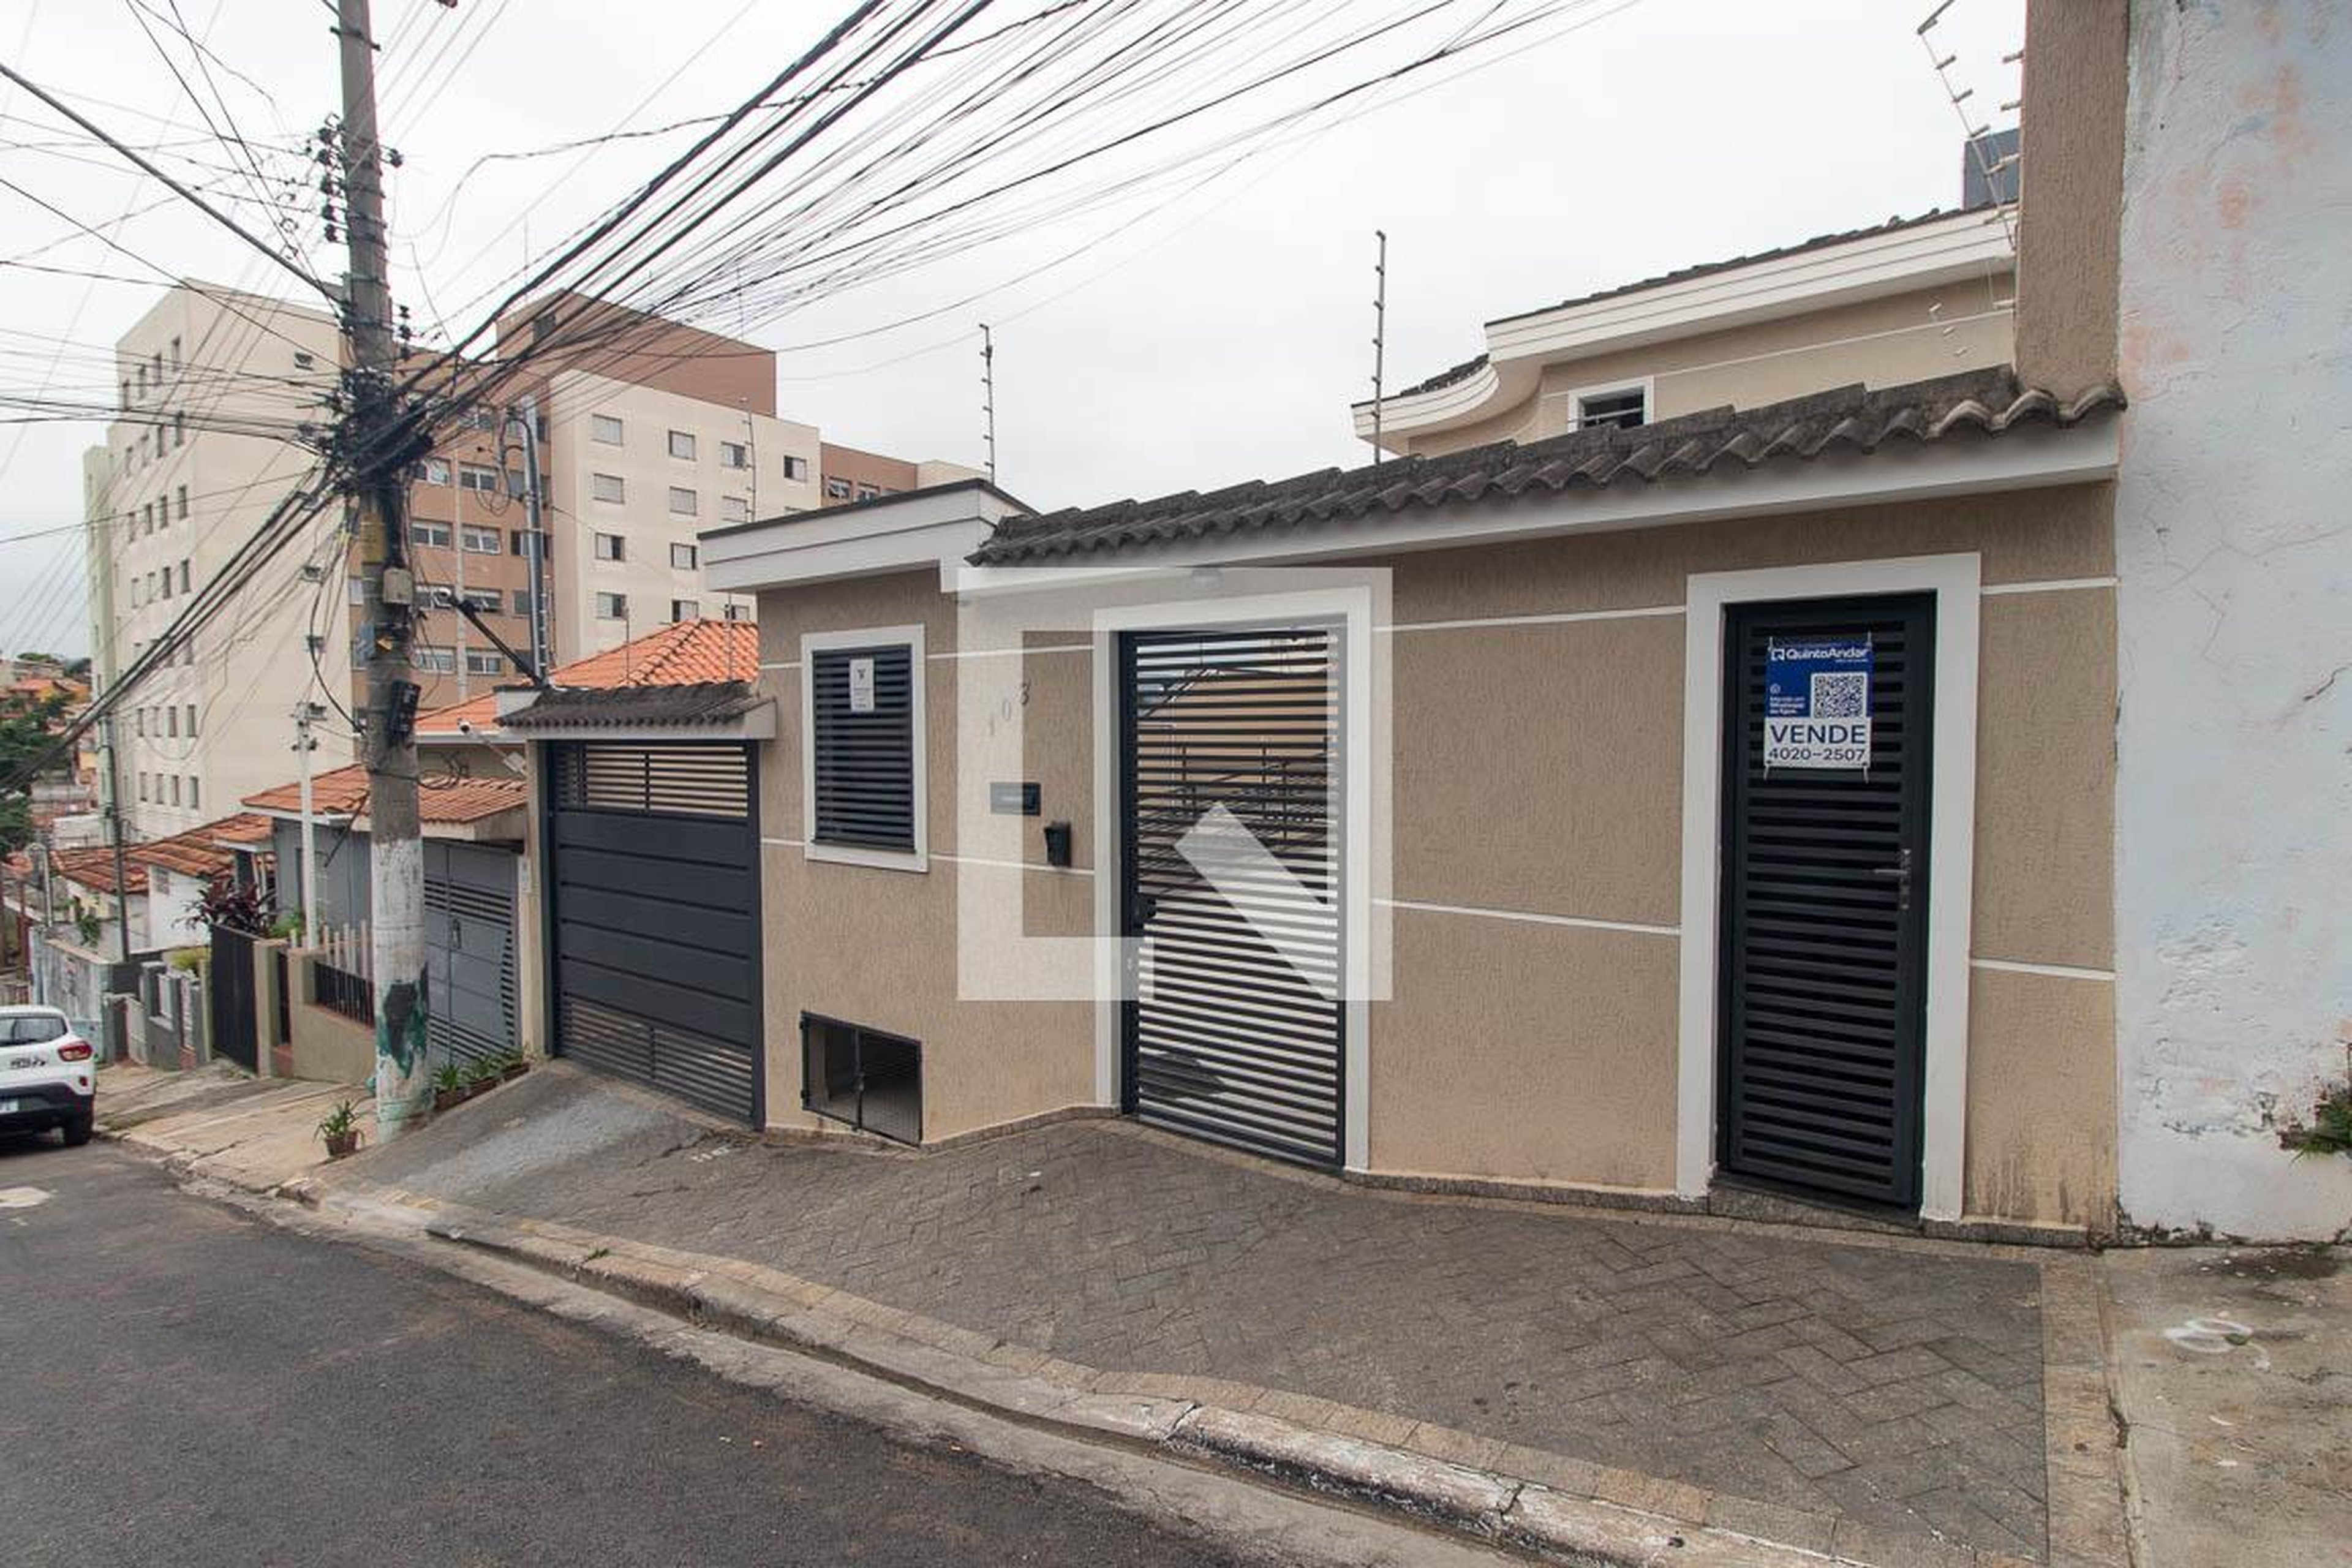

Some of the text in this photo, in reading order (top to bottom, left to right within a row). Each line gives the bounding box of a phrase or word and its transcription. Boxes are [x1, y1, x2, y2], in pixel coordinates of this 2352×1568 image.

[1787, 647, 1869, 660] QuintoAndar
[1770, 725, 1866, 744] VENDE
[1768, 748, 1865, 761] 4020-2507
